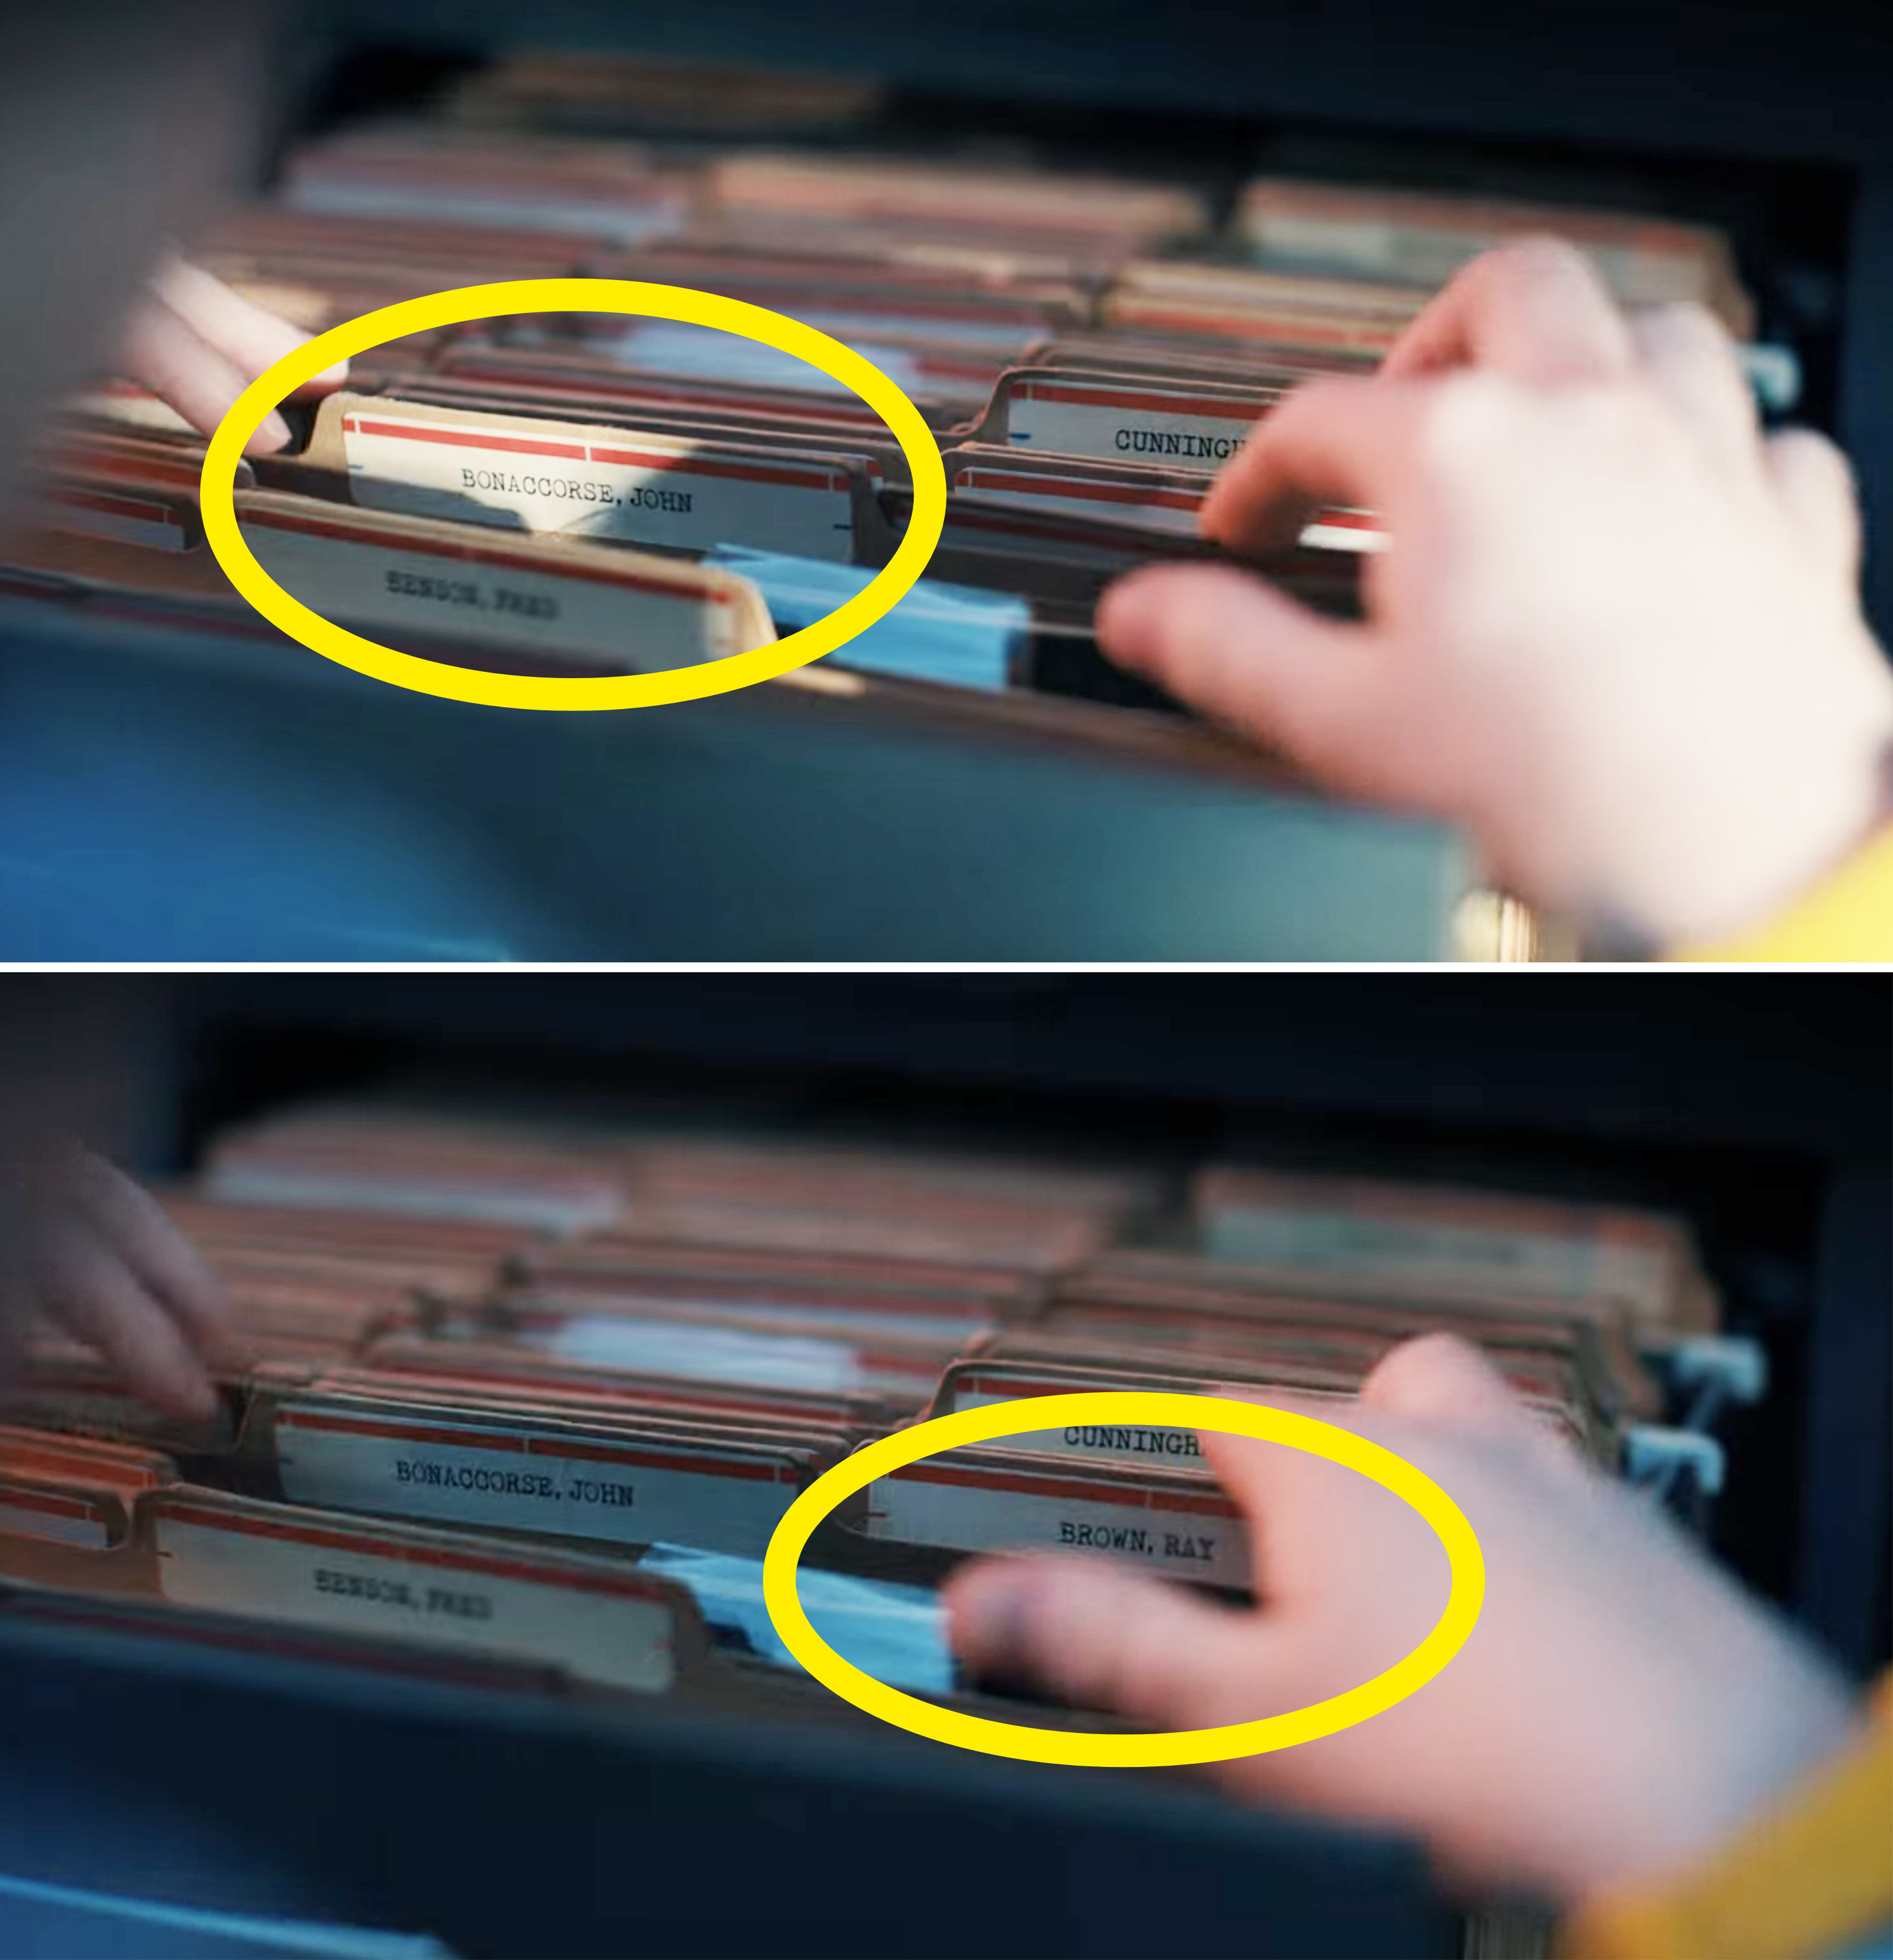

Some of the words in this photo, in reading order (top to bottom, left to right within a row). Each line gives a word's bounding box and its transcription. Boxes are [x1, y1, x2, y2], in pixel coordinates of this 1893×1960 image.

[462, 468, 622, 505] BONACCORSE,
[630, 487, 693, 513] JOHN
[1064, 1425, 1205, 1457] CUNNINGH
[396, 1460, 561, 1500] BONACCORSE,
[569, 1479, 635, 1506] JOHN
[1059, 1521, 1153, 1555] BROWN,
[1164, 1534, 1215, 1561] RAY
